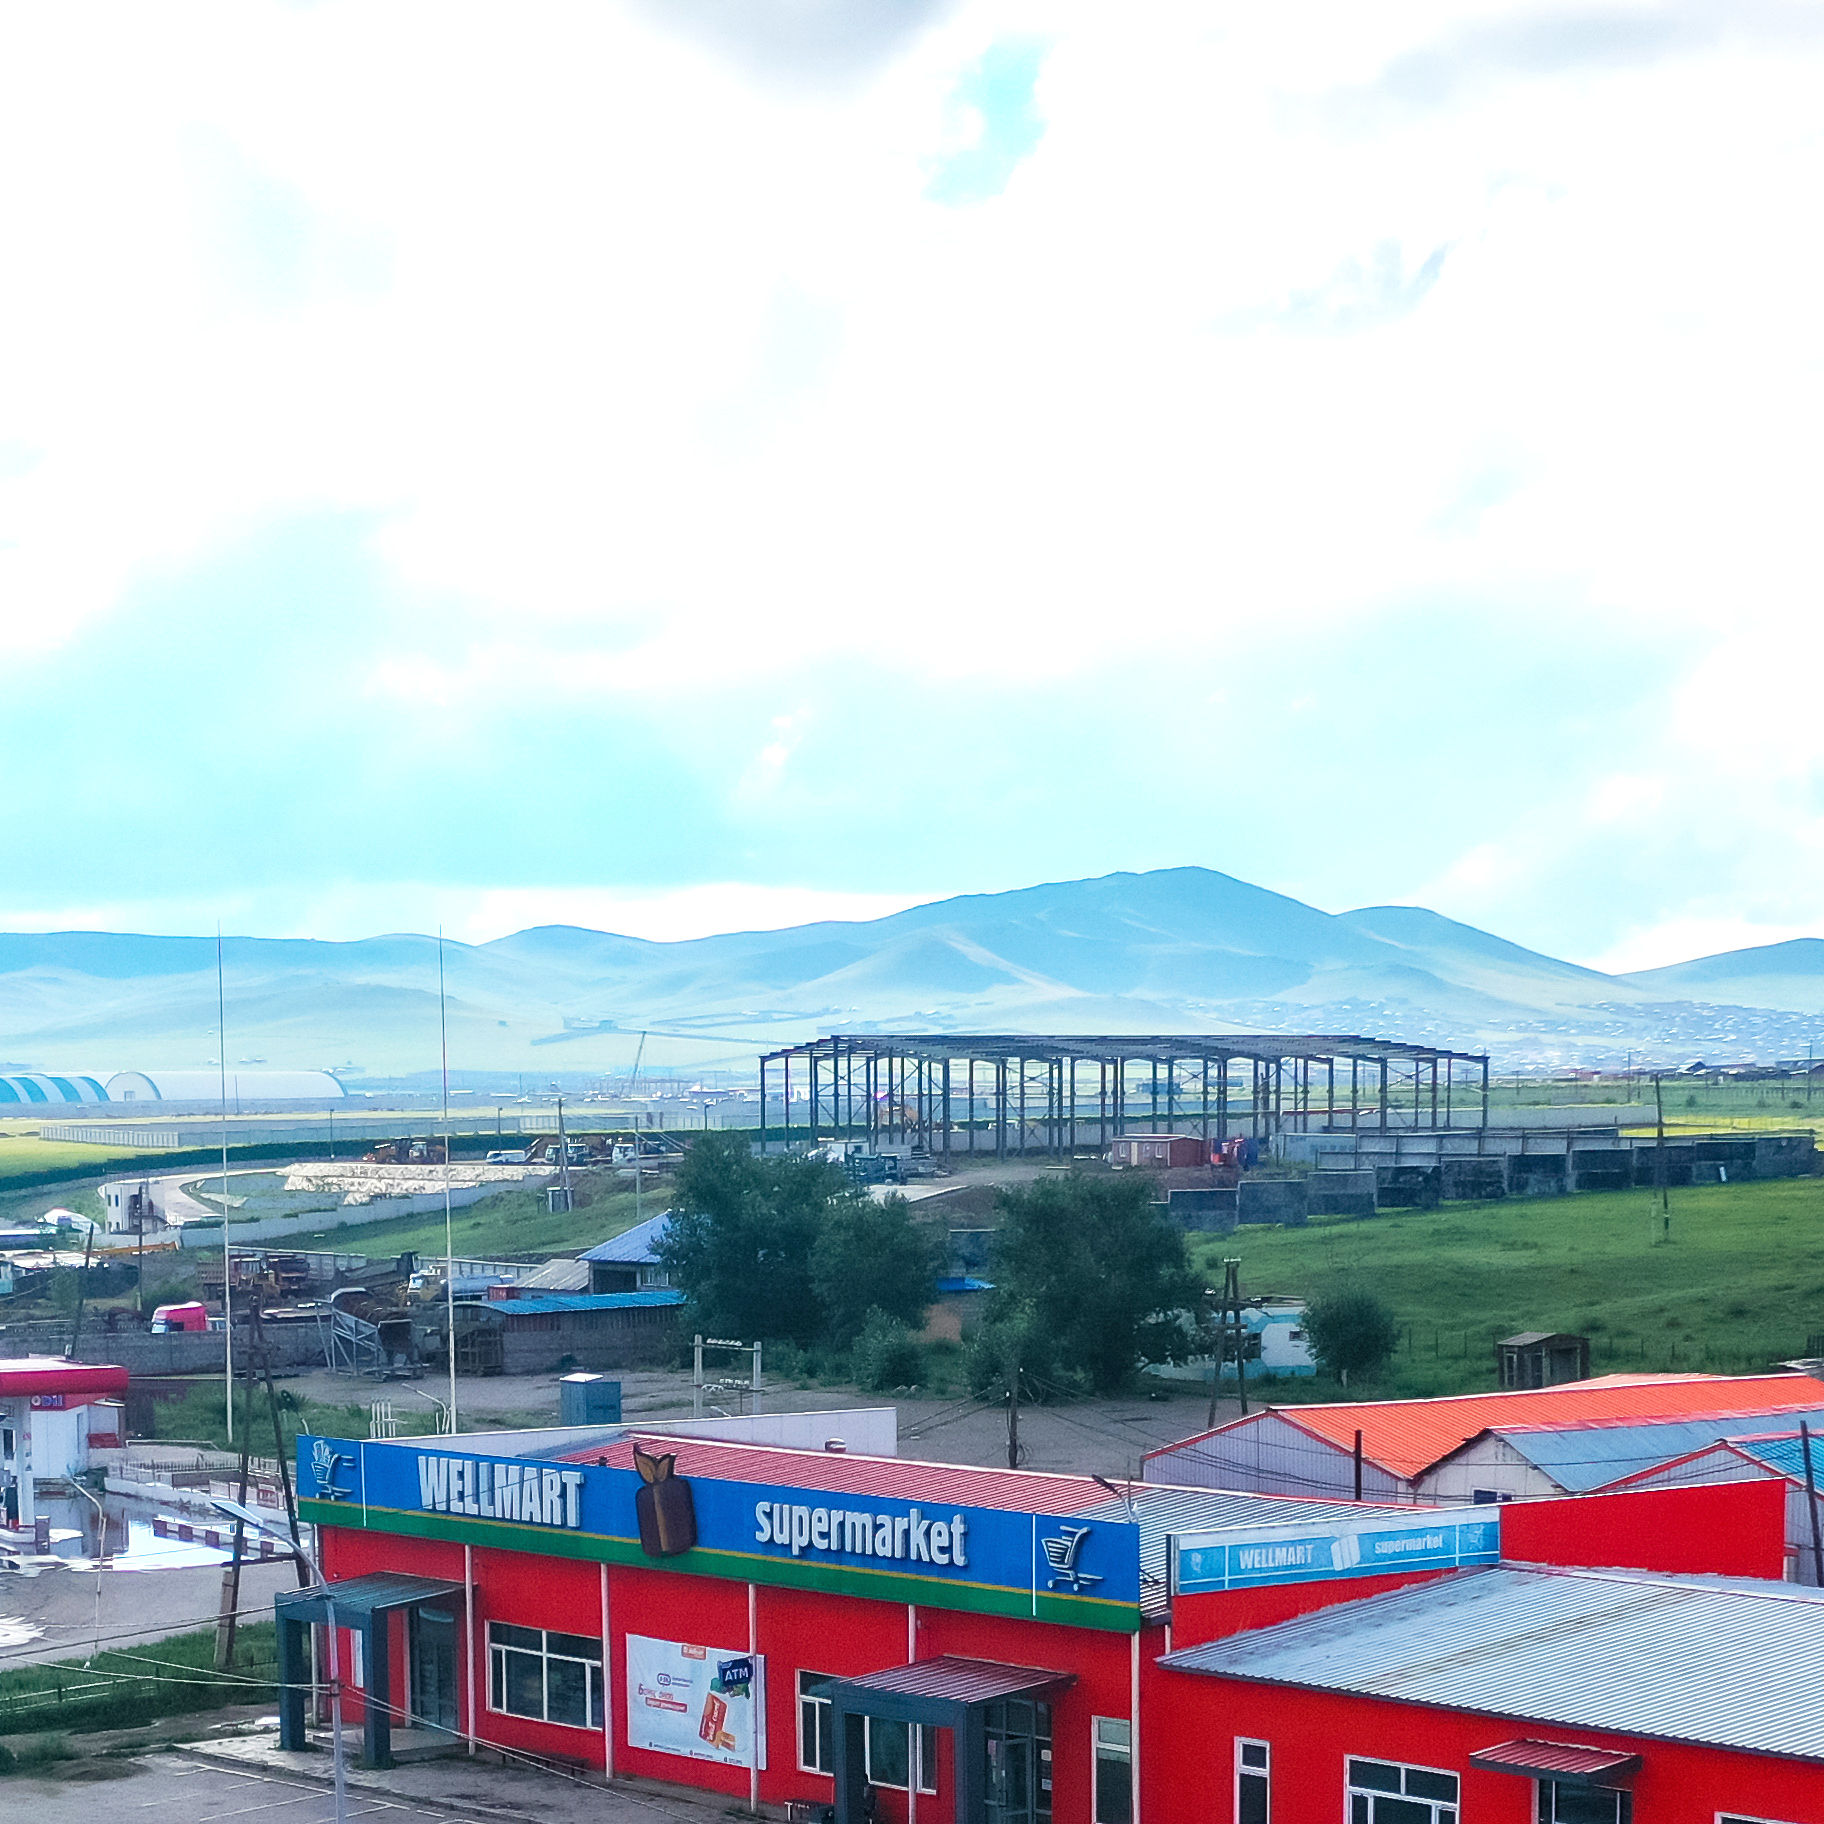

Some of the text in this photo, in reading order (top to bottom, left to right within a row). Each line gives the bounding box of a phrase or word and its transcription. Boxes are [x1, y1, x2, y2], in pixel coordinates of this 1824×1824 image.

[418, 1455, 969, 1567] WELLMART supermarket
[1239, 1534, 1444, 1570] WELLMART supermarket
[725, 1667, 749, 1682] ATM
